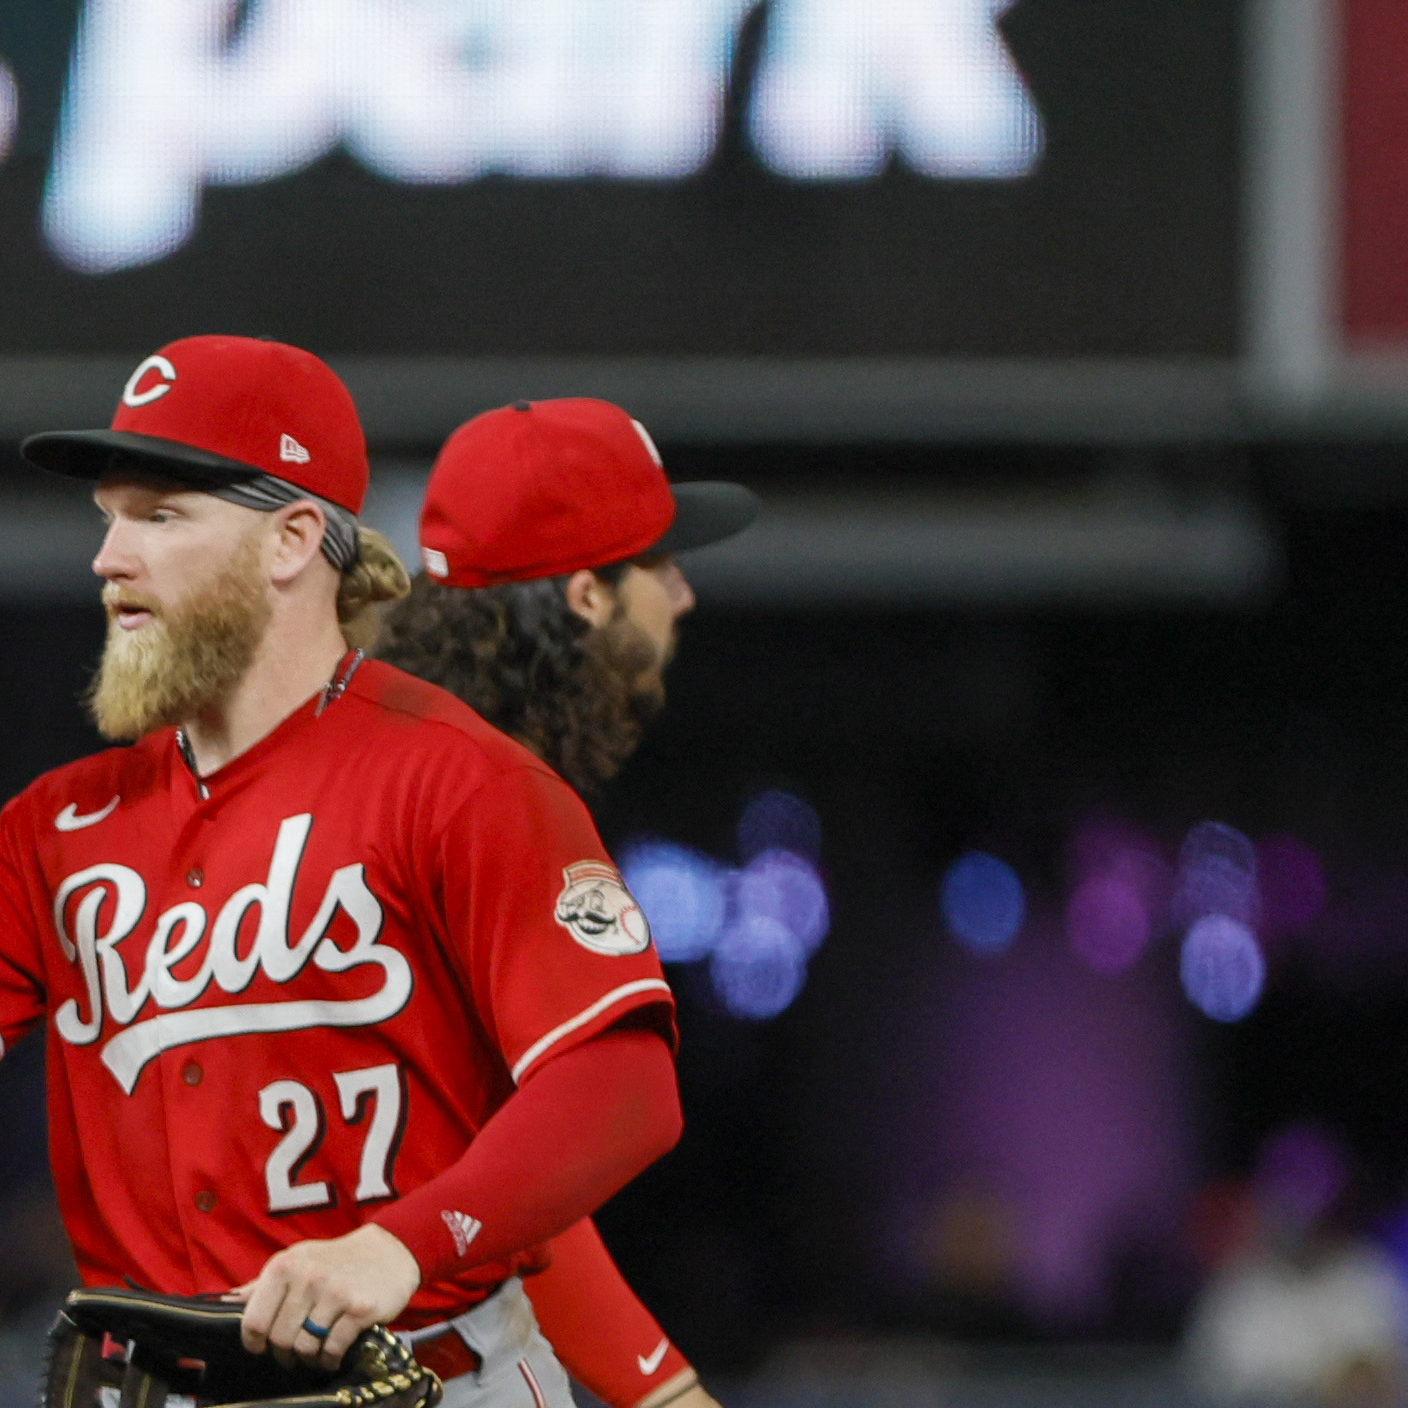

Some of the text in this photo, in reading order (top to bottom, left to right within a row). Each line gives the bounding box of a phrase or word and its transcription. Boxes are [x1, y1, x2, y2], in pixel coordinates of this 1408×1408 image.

[123, 355, 177, 408] C
[54, 813, 413, 1095] Reds
[258, 1064, 409, 1216] 27
